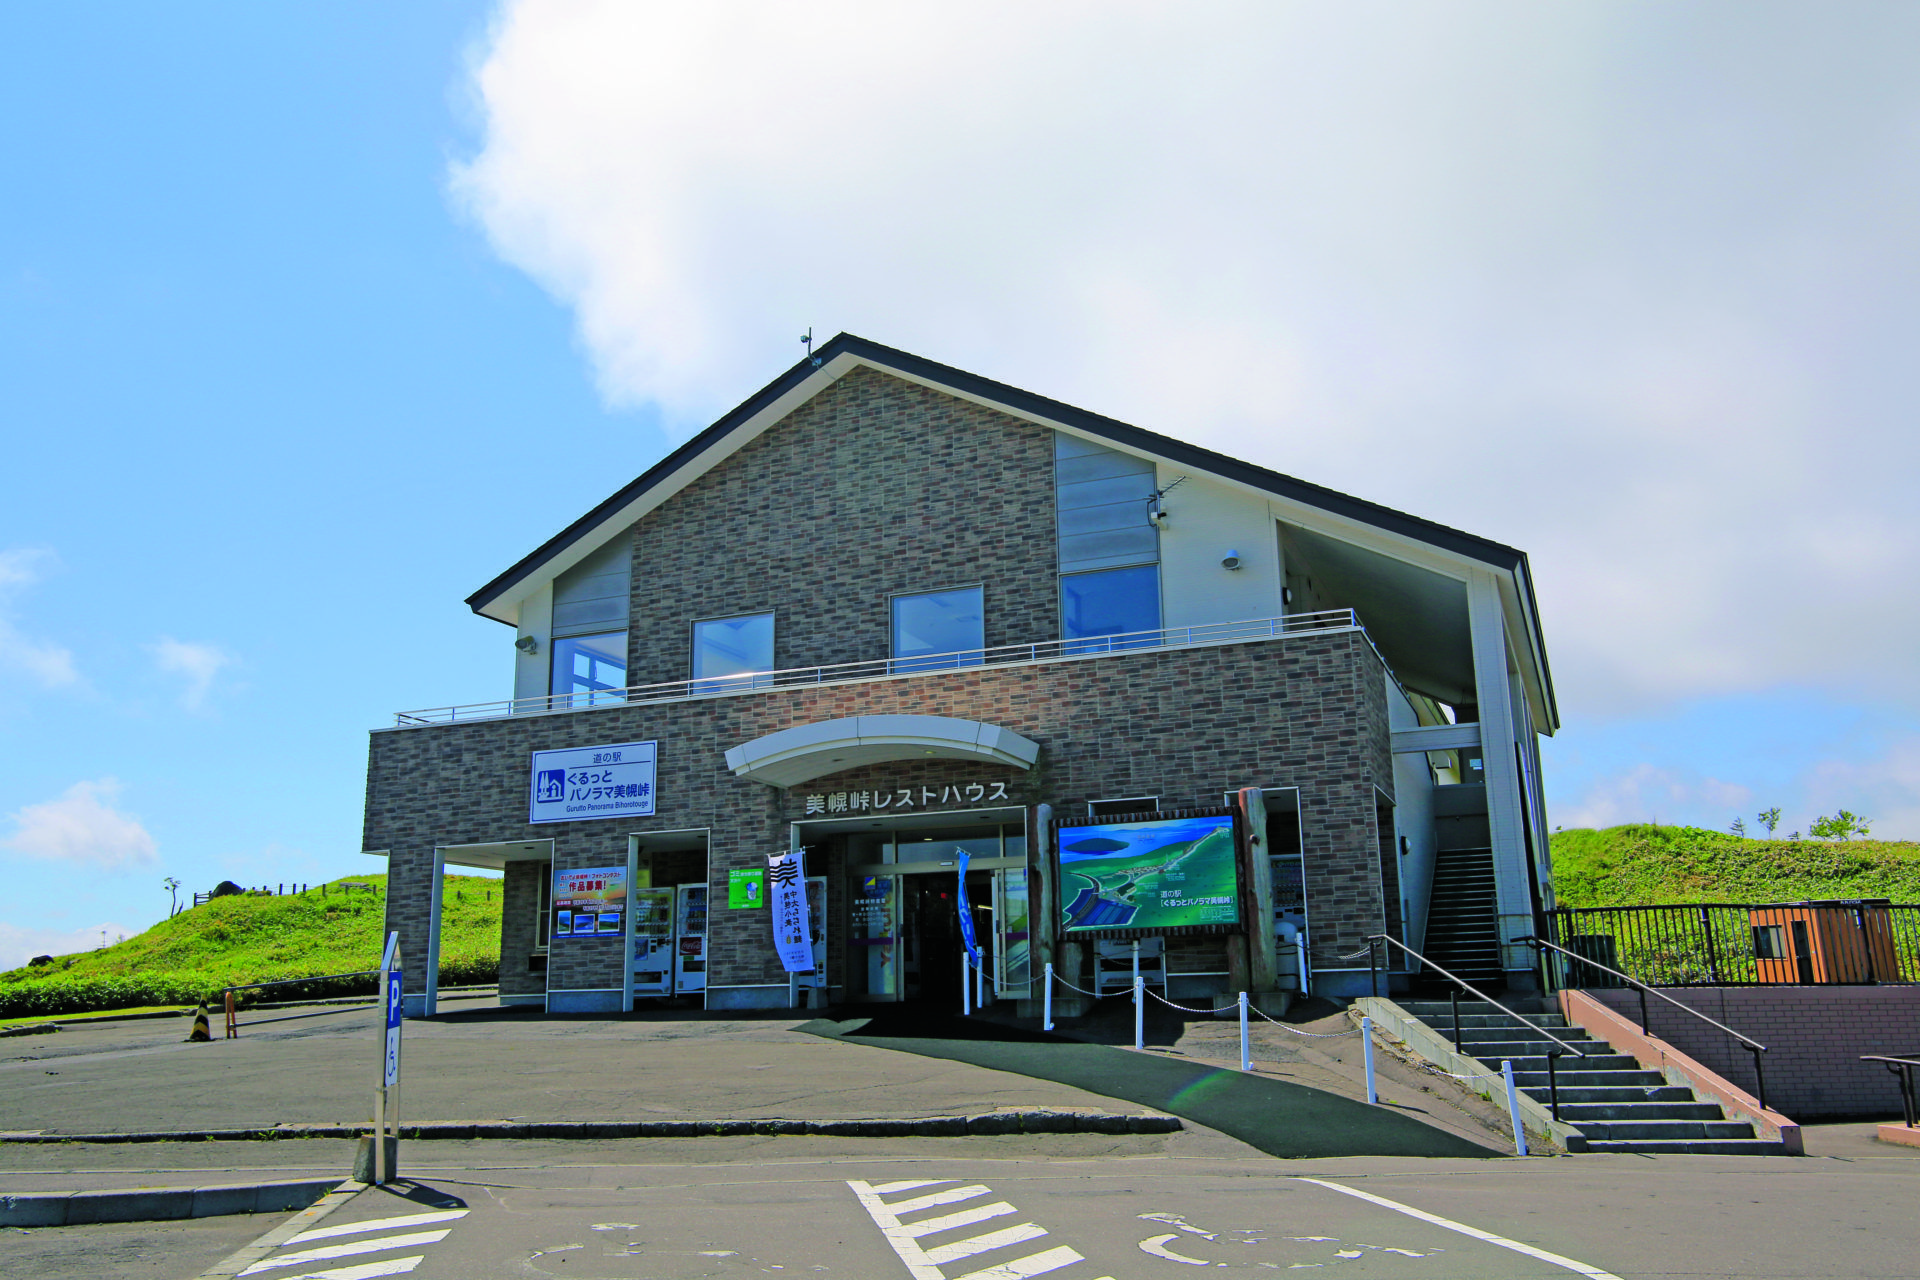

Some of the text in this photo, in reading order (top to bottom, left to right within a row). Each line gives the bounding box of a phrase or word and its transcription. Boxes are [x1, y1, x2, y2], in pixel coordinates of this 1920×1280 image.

[593, 752, 622, 763] 道の駅
[567, 770, 613, 785] ぐるっと
[570, 783, 650, 801] パノラマ美幌峠
[806, 782, 1009, 815] 美幌峠レストハウス
[566, 800, 649, 813] Gurutto Panorama Bihorotouge
[569, 880, 606, 892] 作品募集！
[1160, 890, 1182, 898] 道の駅
[390, 979, 399, 1022] P
